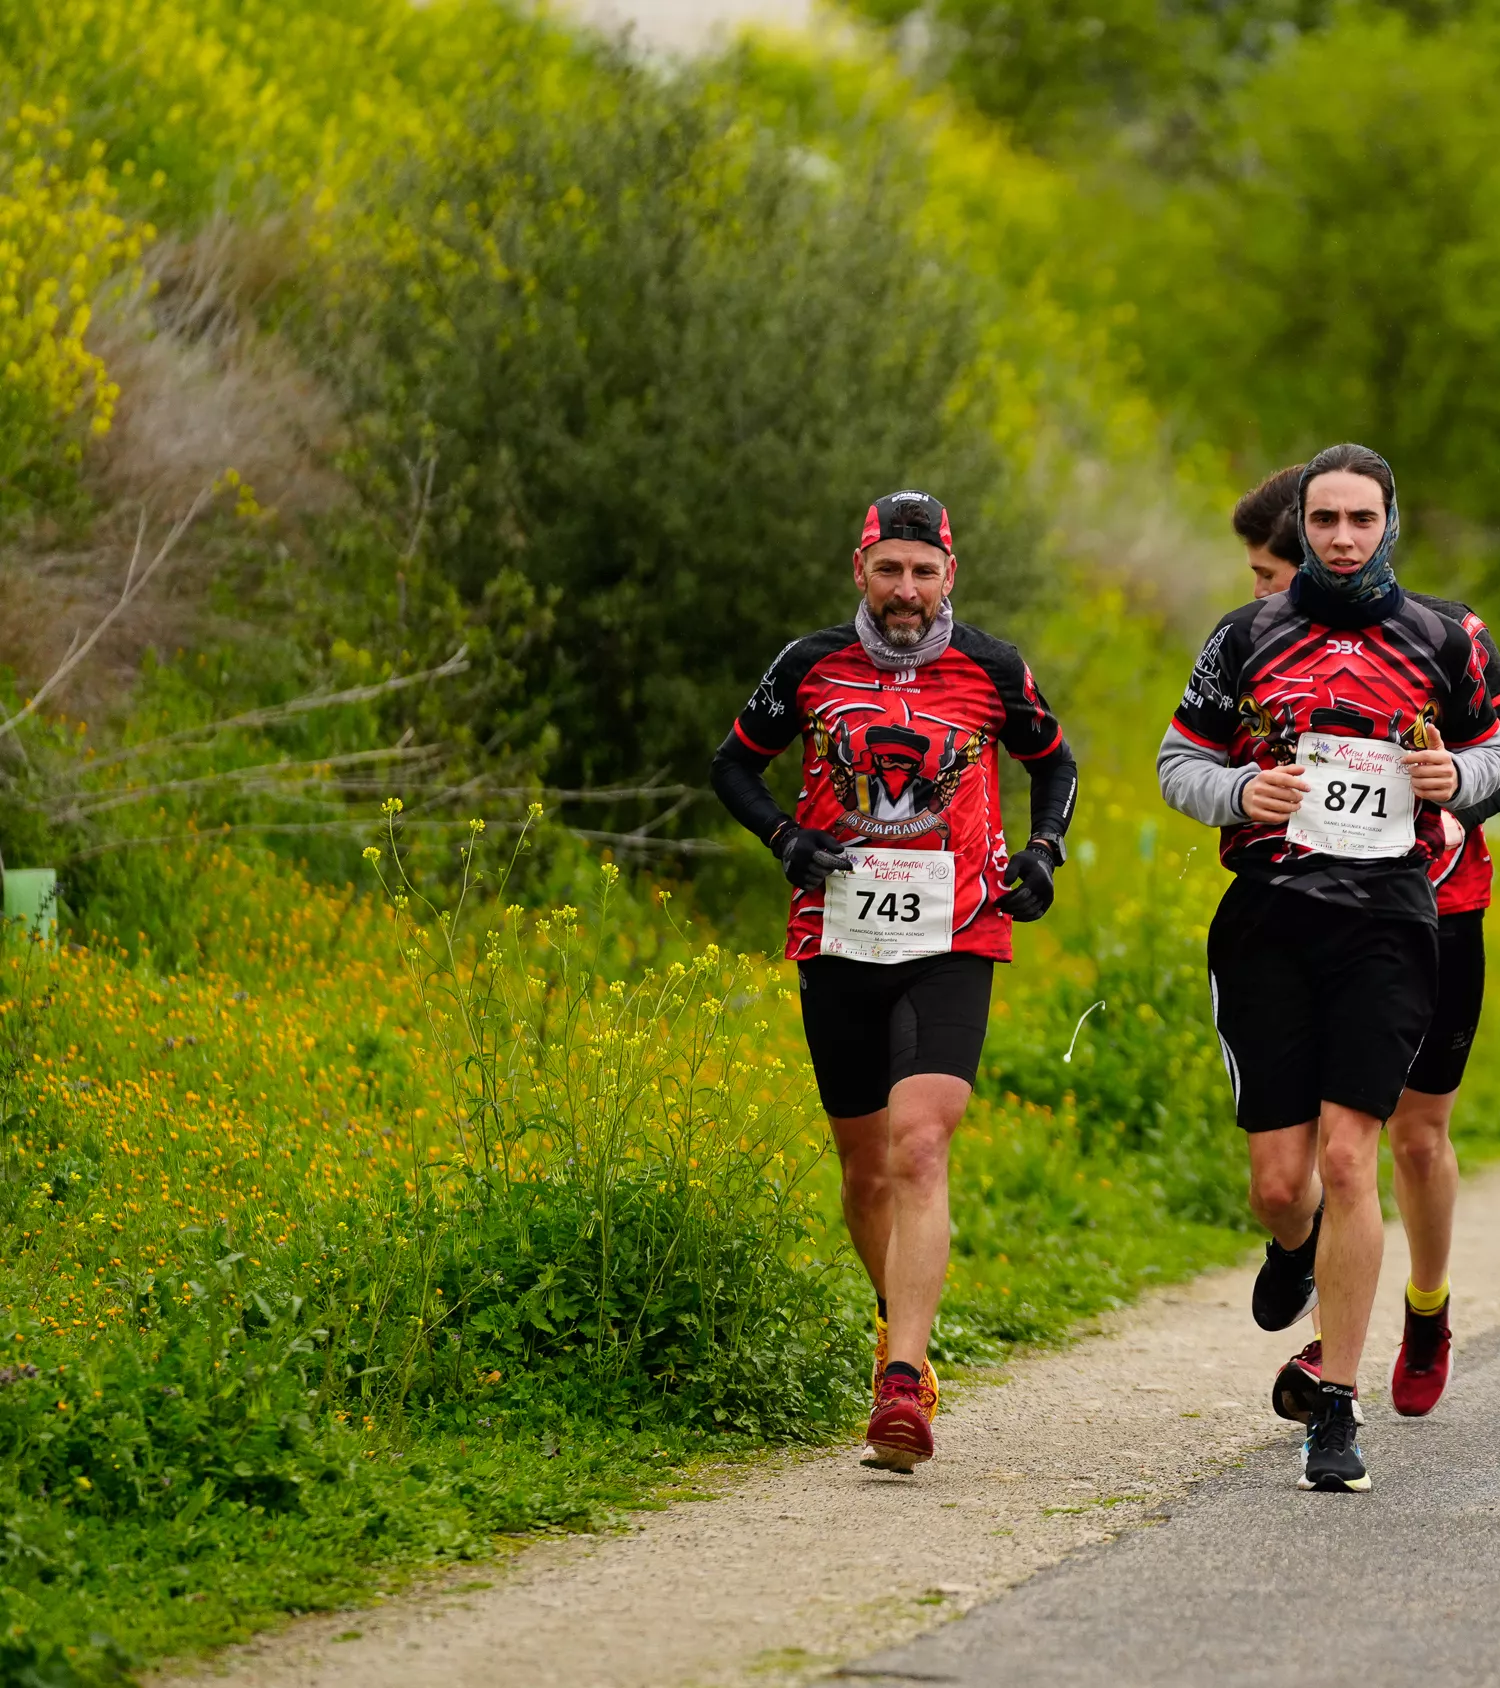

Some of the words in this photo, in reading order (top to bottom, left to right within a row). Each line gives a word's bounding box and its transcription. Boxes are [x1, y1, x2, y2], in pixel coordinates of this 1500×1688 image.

[1326, 639, 1364, 656] DBK
[1349, 760, 1386, 774] LUCENA
[1324, 780, 1388, 819] 871
[846, 813, 860, 827] LOS
[859, 814, 939, 835] TEMPRANILLOS
[875, 868, 914, 882] LUCENA
[856, 890, 921, 922] 743
